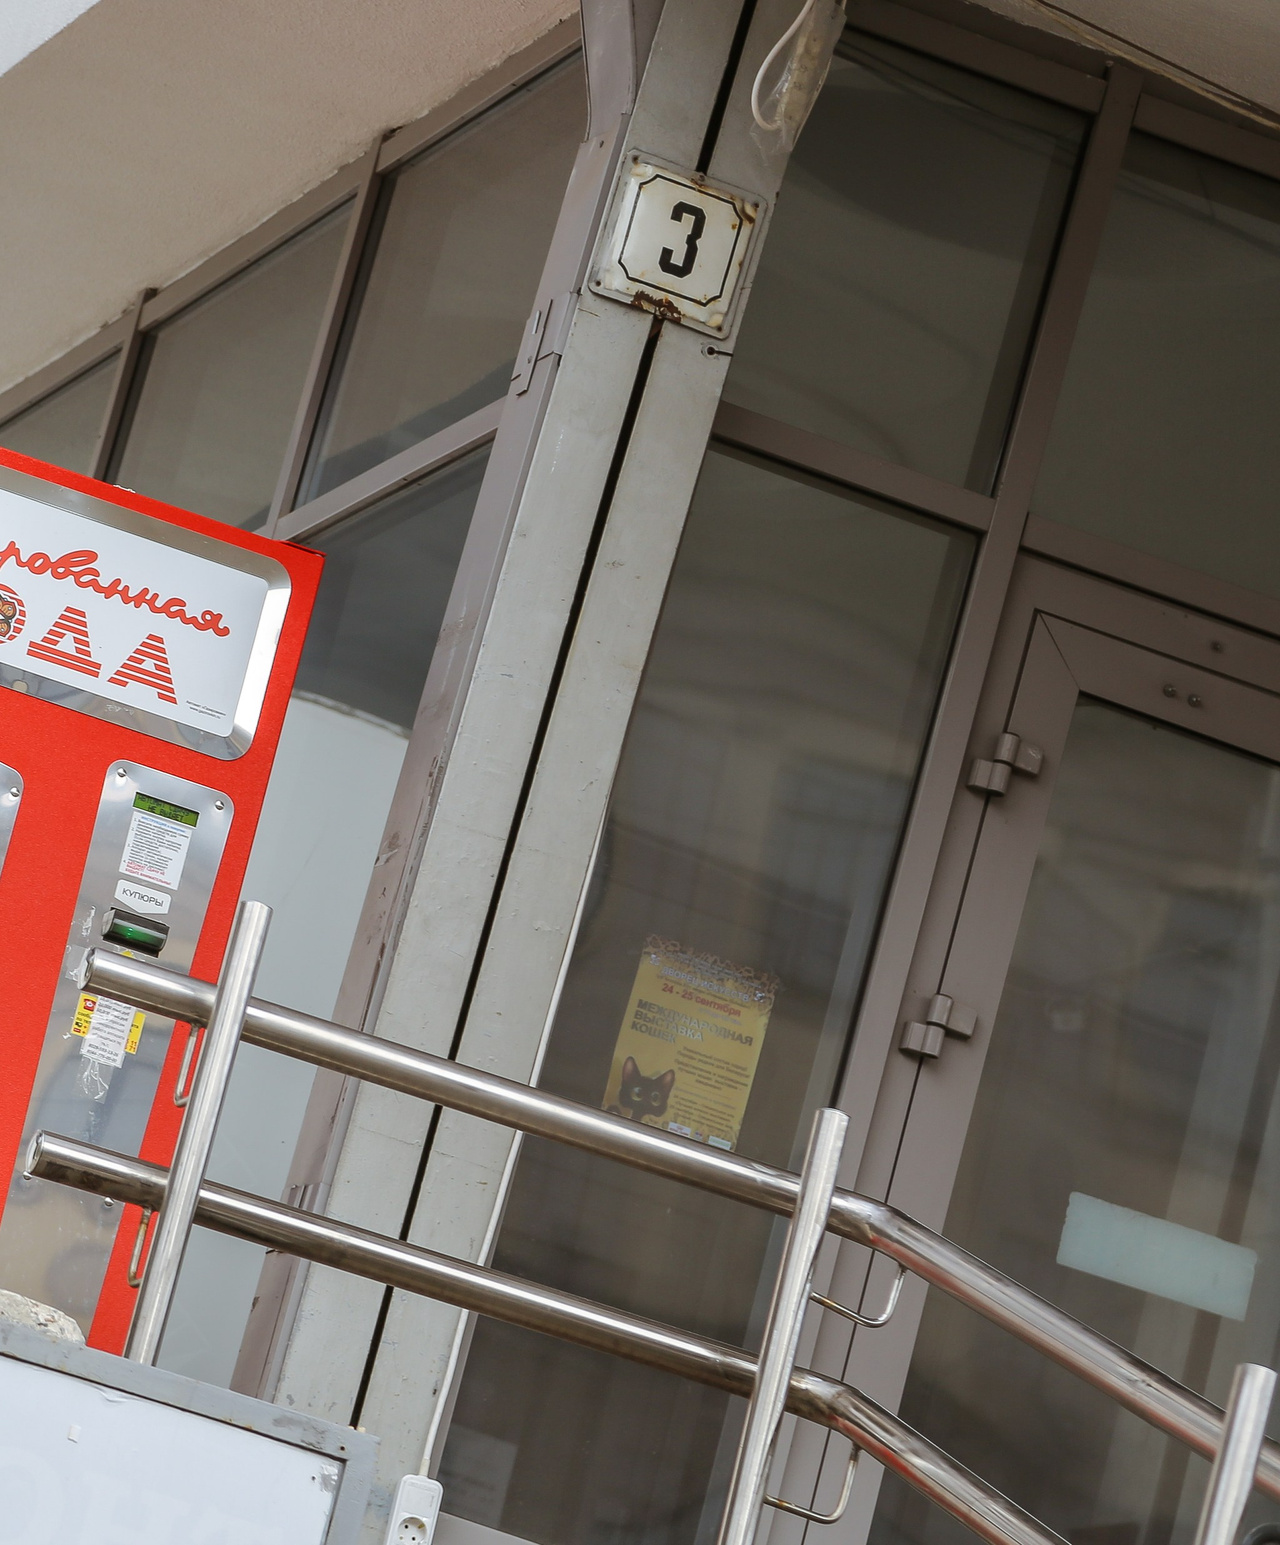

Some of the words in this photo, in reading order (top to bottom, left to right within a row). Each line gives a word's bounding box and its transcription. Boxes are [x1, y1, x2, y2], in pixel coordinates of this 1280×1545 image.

[659, 201, 706, 279] 3
[147, 804, 156, 812] НЕ
[122, 887, 164, 907] КУПЮРЫ
[660, 965, 699, 985] ДВОРЕЦ
[698, 979, 751, 1002] ИСКУССТВ
[661, 982, 675, 994] 24
[680, 989, 694, 1000] 25
[693, 993, 742, 1018] сентября
[629, 1020, 677, 1043] КОШЕК
[632, 1009, 706, 1041] ВЫСТАВКА
[634, 1000, 755, 1045] МЕЖДУНАРОДНАЯ
